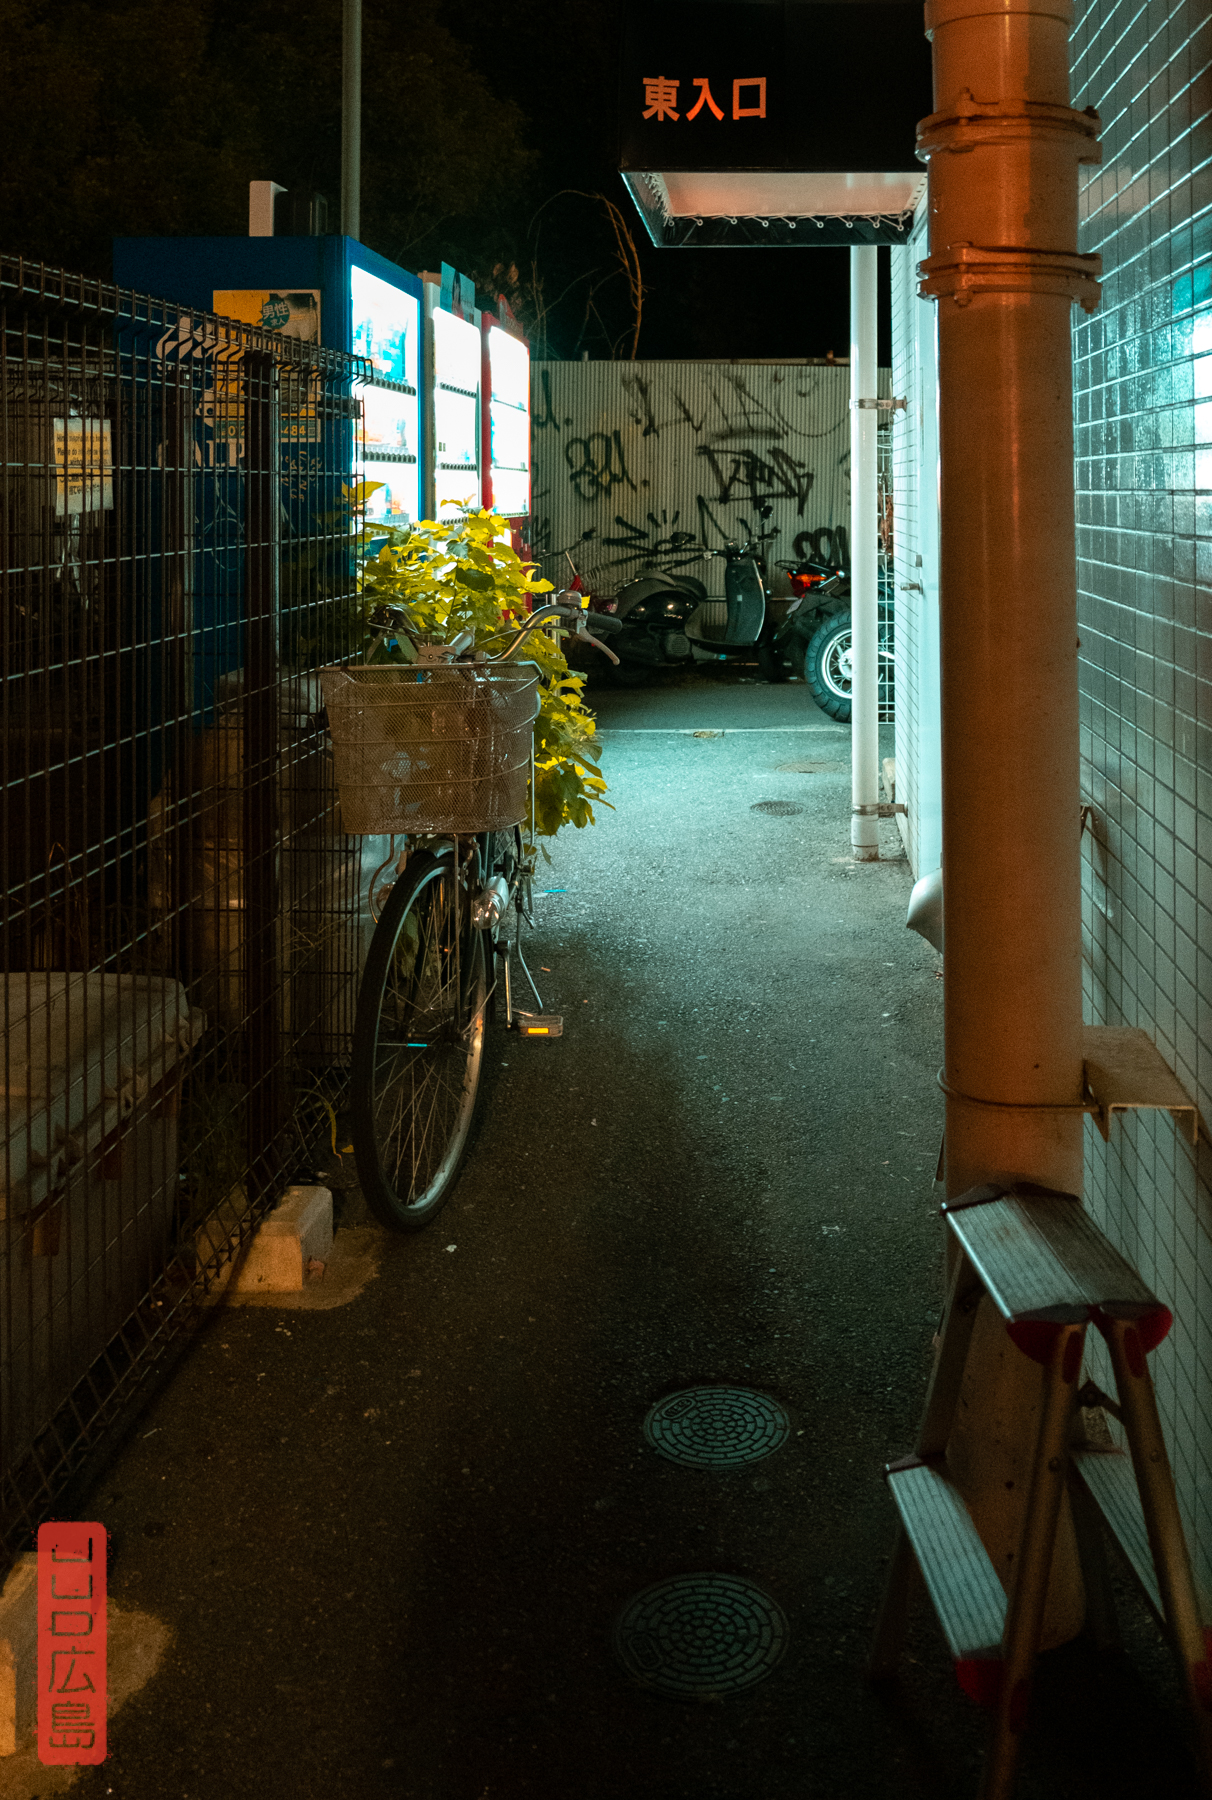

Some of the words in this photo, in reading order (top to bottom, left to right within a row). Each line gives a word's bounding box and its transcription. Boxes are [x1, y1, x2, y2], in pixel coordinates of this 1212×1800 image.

[641, 75, 767, 122] 東入口
[262, 301, 290, 320] 男性
